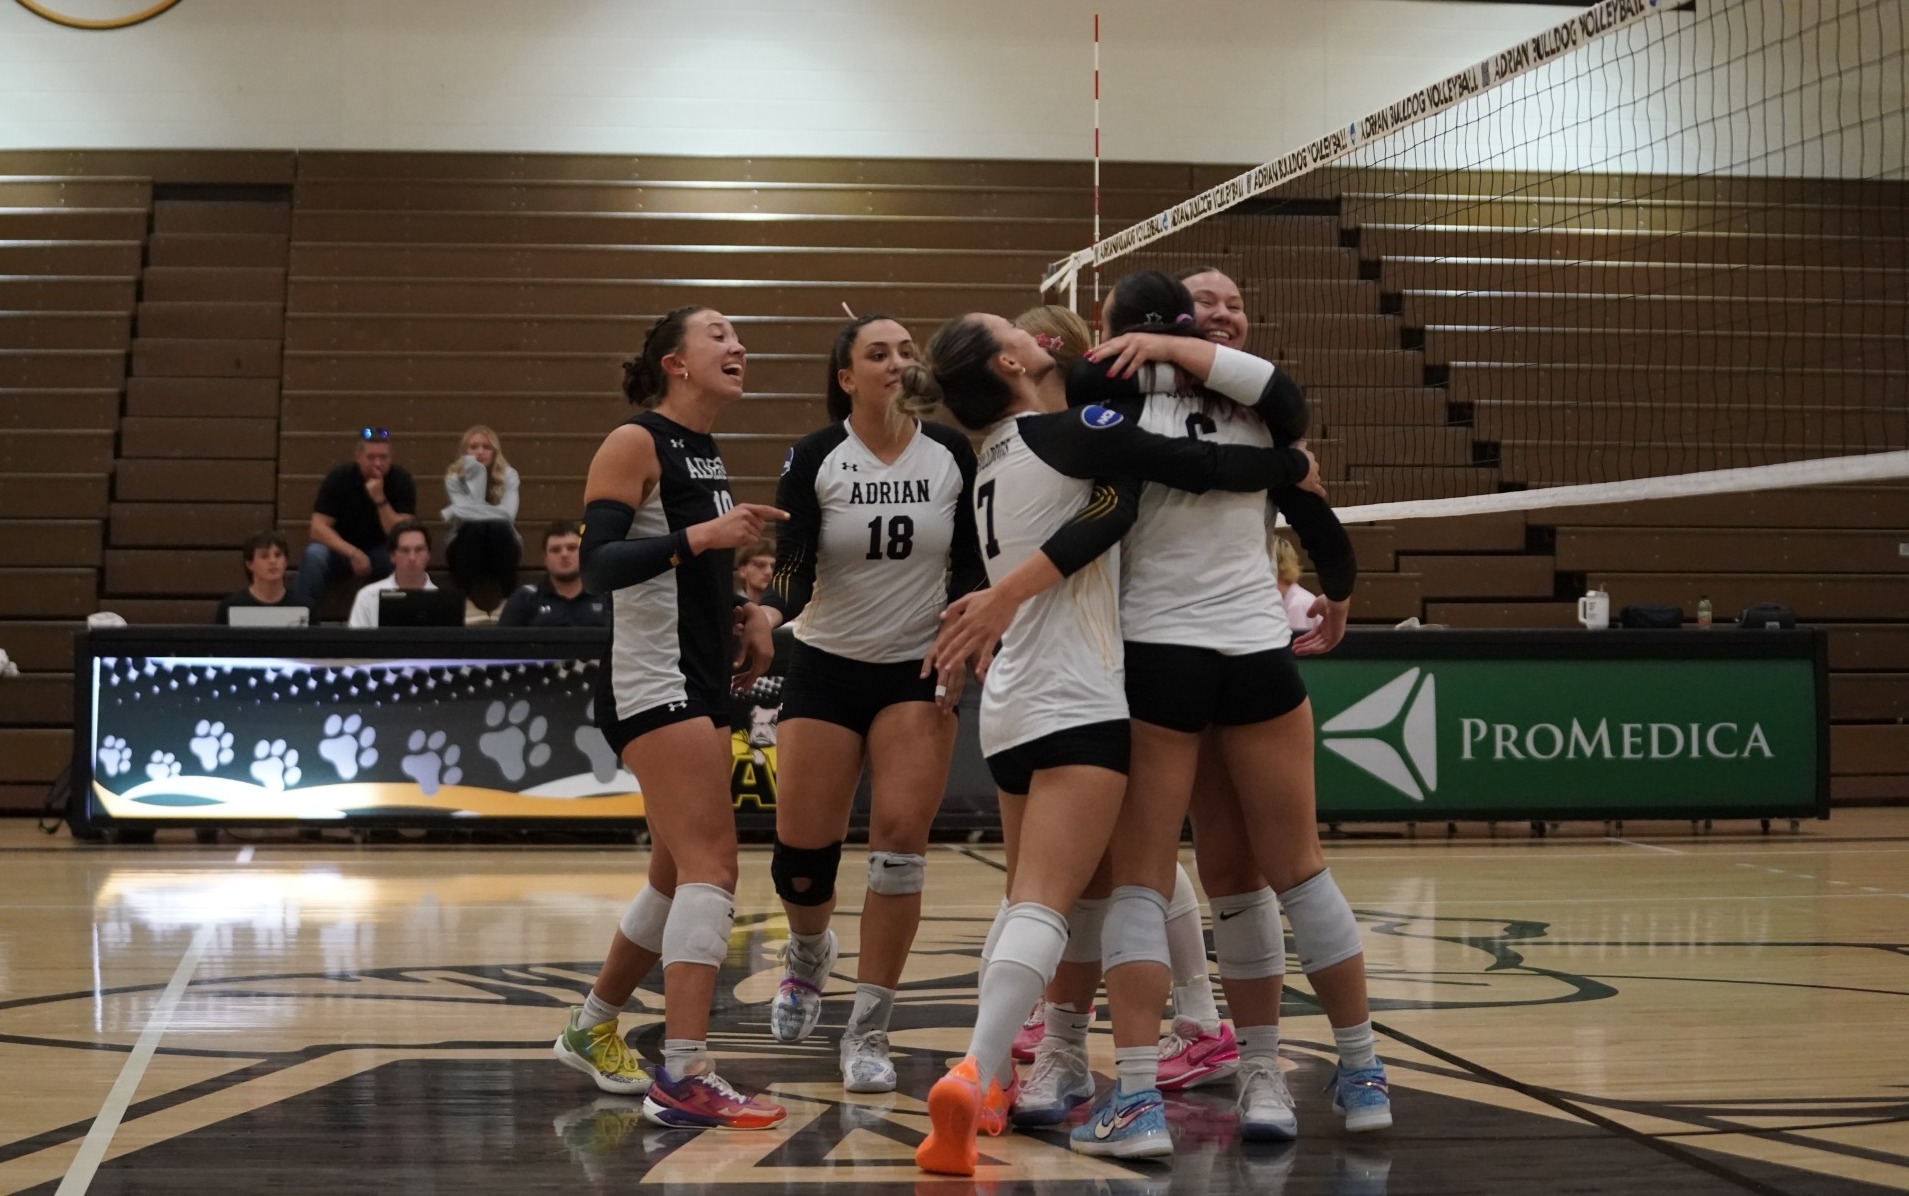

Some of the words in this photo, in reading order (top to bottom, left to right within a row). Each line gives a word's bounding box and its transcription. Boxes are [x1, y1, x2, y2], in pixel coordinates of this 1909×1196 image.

[1494, 42, 1530, 82] ADRIAN
[1532, 19, 1577, 63] BULLDOG
[1579, 0, 1645, 40] VOLLEYBALL
[1360, 107, 1389, 140] ADRIAN
[1389, 90, 1426, 128] BULLDOG
[1426, 66, 1479, 109] VOLLEYBALL
[1254, 160, 1278, 191] ADRIAN
[1277, 147, 1308, 179] BULLDOG
[1307, 127, 1347, 163] VOLLEYBALL
[849, 479, 931, 505] ADRIAN
[977, 478, 1001, 560] 7
[866, 515, 914, 560] 18
